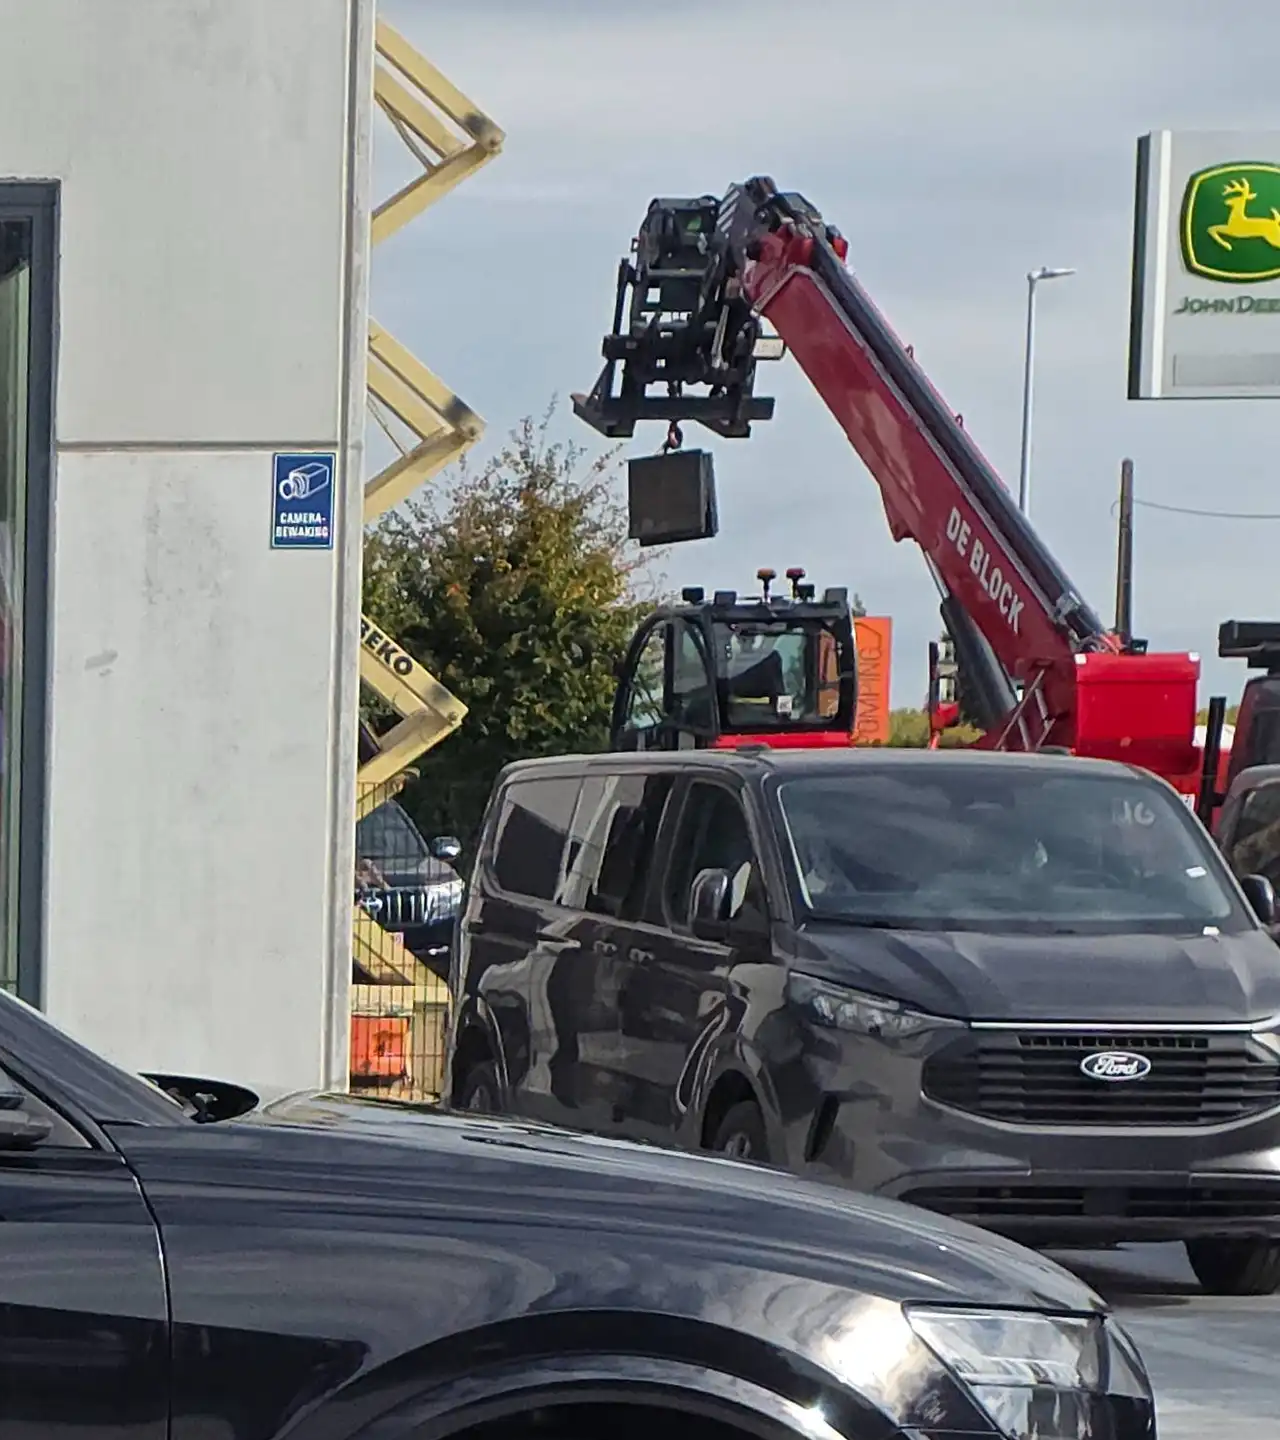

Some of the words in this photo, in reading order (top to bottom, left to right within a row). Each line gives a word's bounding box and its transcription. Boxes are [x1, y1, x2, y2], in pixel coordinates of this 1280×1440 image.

[946, 506, 972, 557] DE
[969, 538, 1025, 635] BLOCK
[1093, 1054, 1140, 1075] Ford
